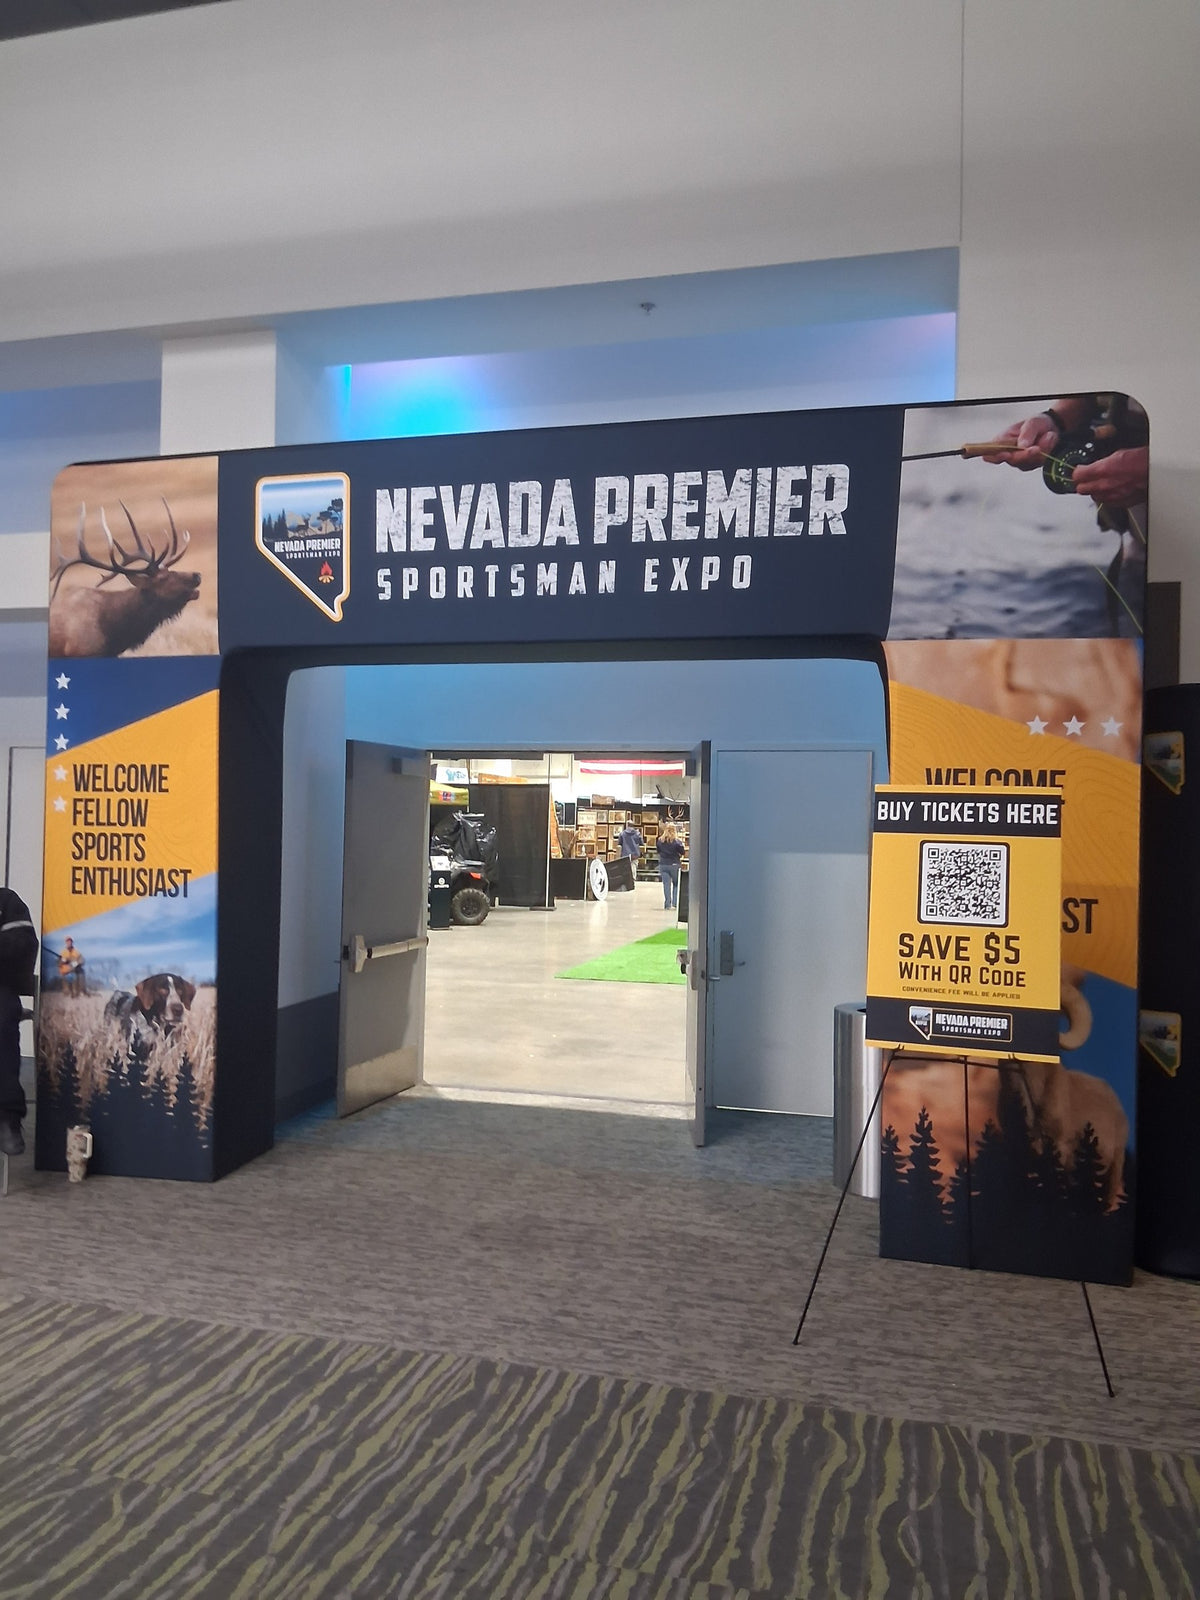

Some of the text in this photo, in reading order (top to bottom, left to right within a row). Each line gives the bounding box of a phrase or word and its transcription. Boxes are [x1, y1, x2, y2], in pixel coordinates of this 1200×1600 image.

[375, 463, 851, 553] NEVADA PREMIER
[274, 538, 341, 553] NEVADA PREMIER
[376, 554, 753, 601] SPORTSMAN EXPO
[73, 764, 169, 793] WELCOME
[72, 798, 149, 827] FELLOW
[877, 801, 1059, 824] BUY TICKETS HERE
[71, 832, 146, 861] SPORTS
[71, 867, 192, 898] ENTHUSIAST
[899, 932, 1020, 965] SAVE $5
[899, 961, 1026, 987] WITH QR CODE
[902, 986, 945, 994] CONVENIENCE
[936, 1014, 968, 1026] NEVADA
[970, 1016, 1008, 1029] PREMIER
